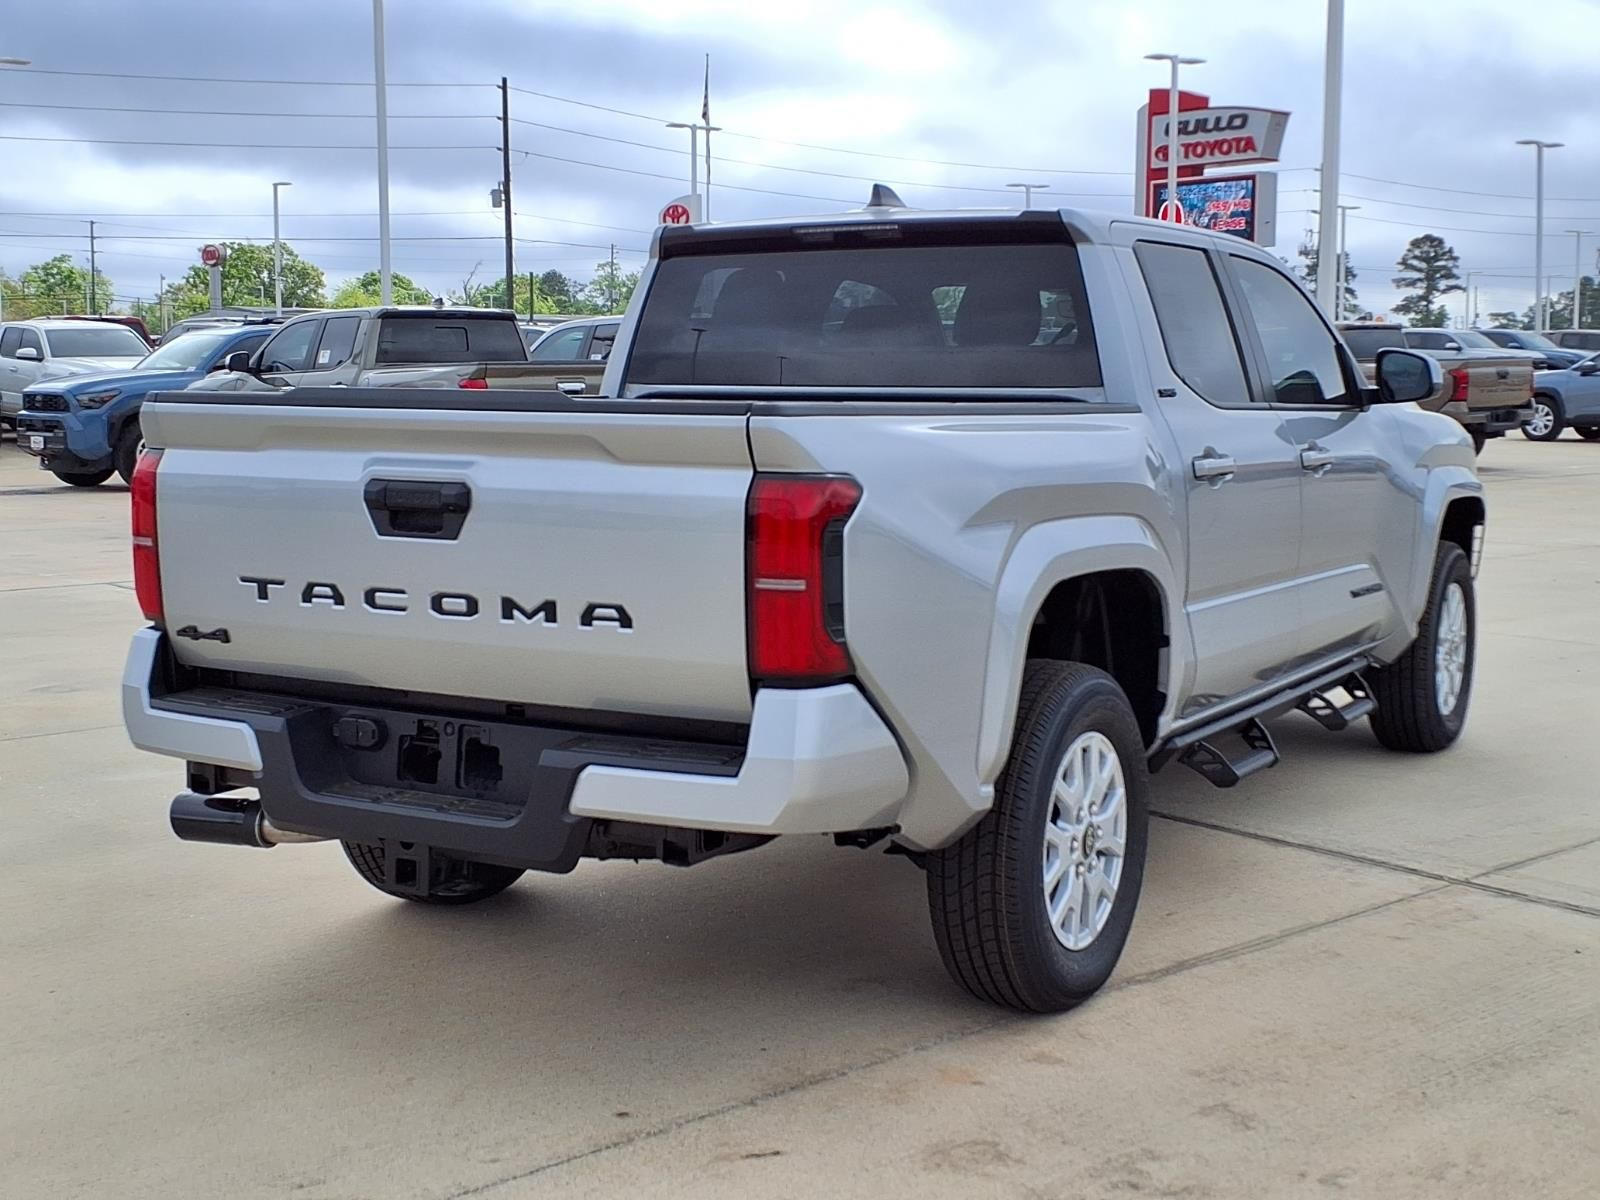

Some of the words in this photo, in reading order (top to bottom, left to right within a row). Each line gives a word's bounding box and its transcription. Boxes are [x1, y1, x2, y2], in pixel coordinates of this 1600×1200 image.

[1180, 135, 1257, 159] TOYOTA
[1211, 217, 1246, 231] LEASE
[238, 575, 633, 630] TACOMA
